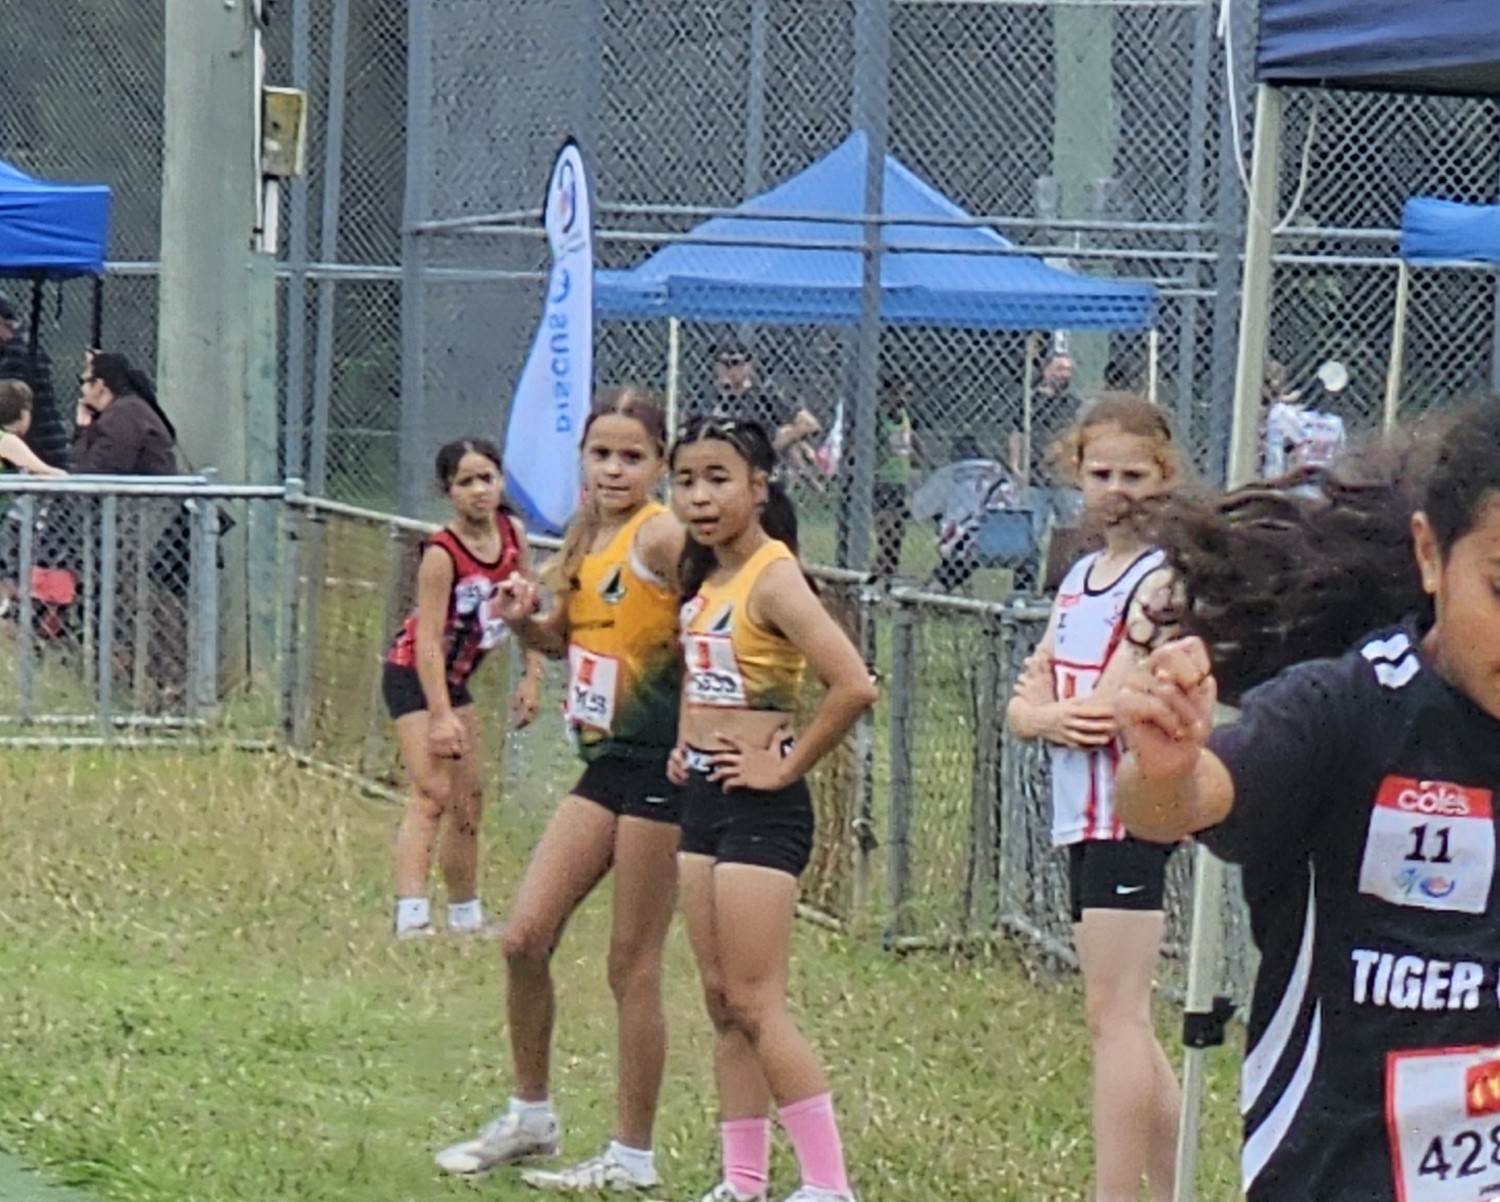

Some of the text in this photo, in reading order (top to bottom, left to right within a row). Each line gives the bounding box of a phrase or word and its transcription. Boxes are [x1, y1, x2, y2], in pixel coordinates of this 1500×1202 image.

[1397, 783, 1470, 815] coles
[1404, 822, 1452, 863] 11
[1351, 949, 1484, 1010] TIGER
